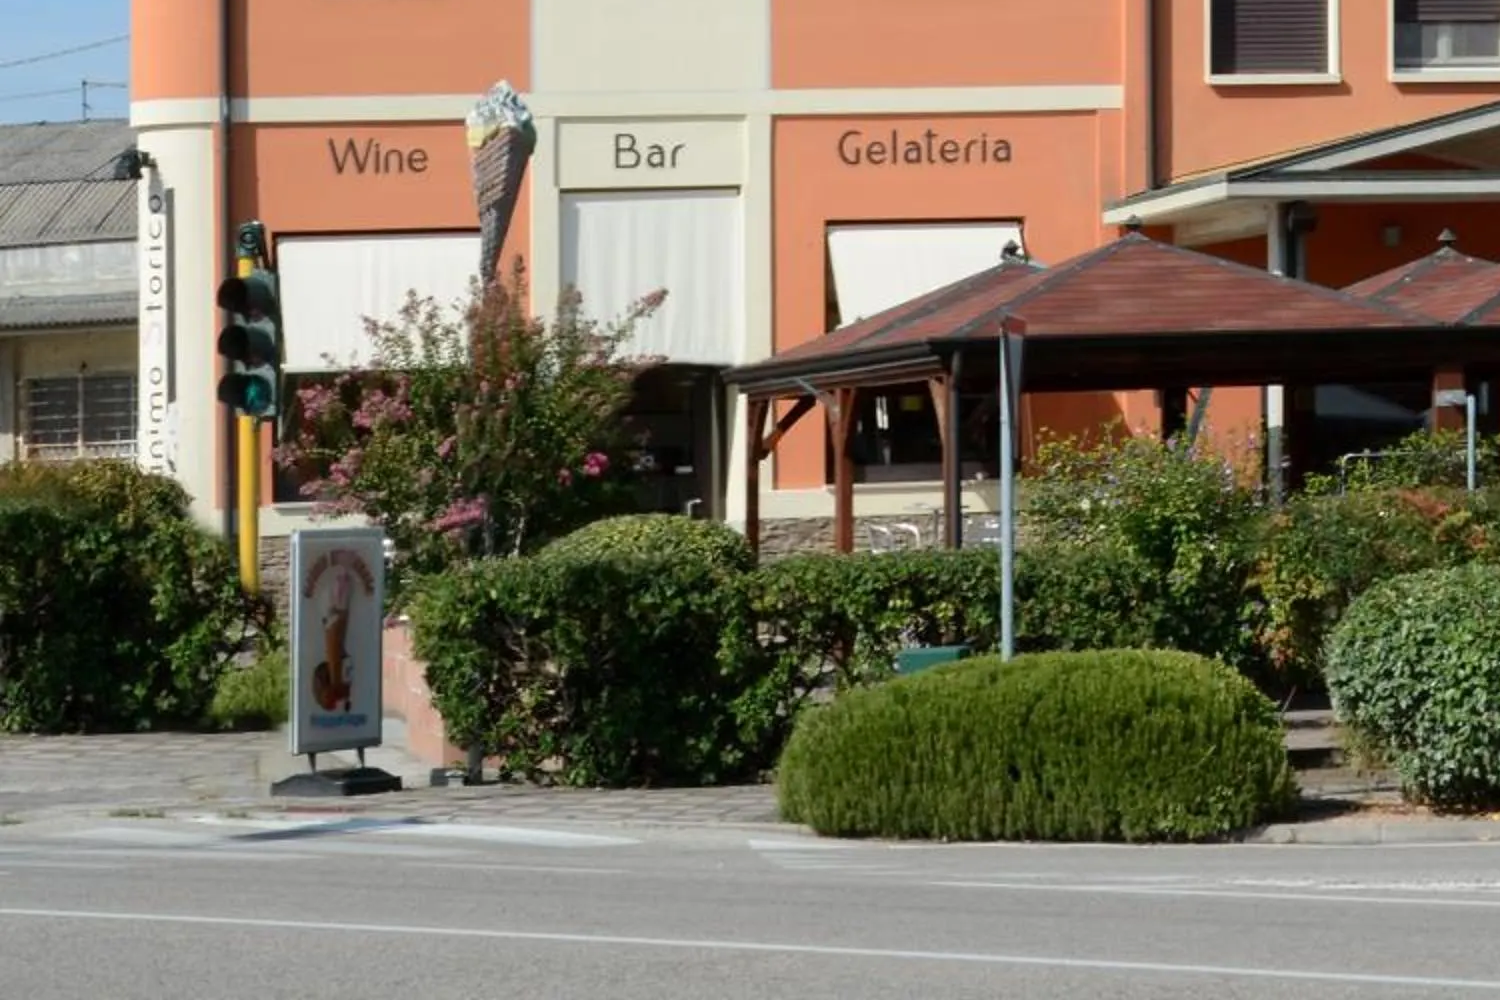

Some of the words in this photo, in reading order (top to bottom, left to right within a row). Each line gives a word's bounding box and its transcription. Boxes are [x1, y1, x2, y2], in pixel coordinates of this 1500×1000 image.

[327, 137, 428, 175] Wine
[613, 133, 685, 169] Bar
[838, 129, 1012, 165] Gelateria
[143, 194, 164, 346] Storico
